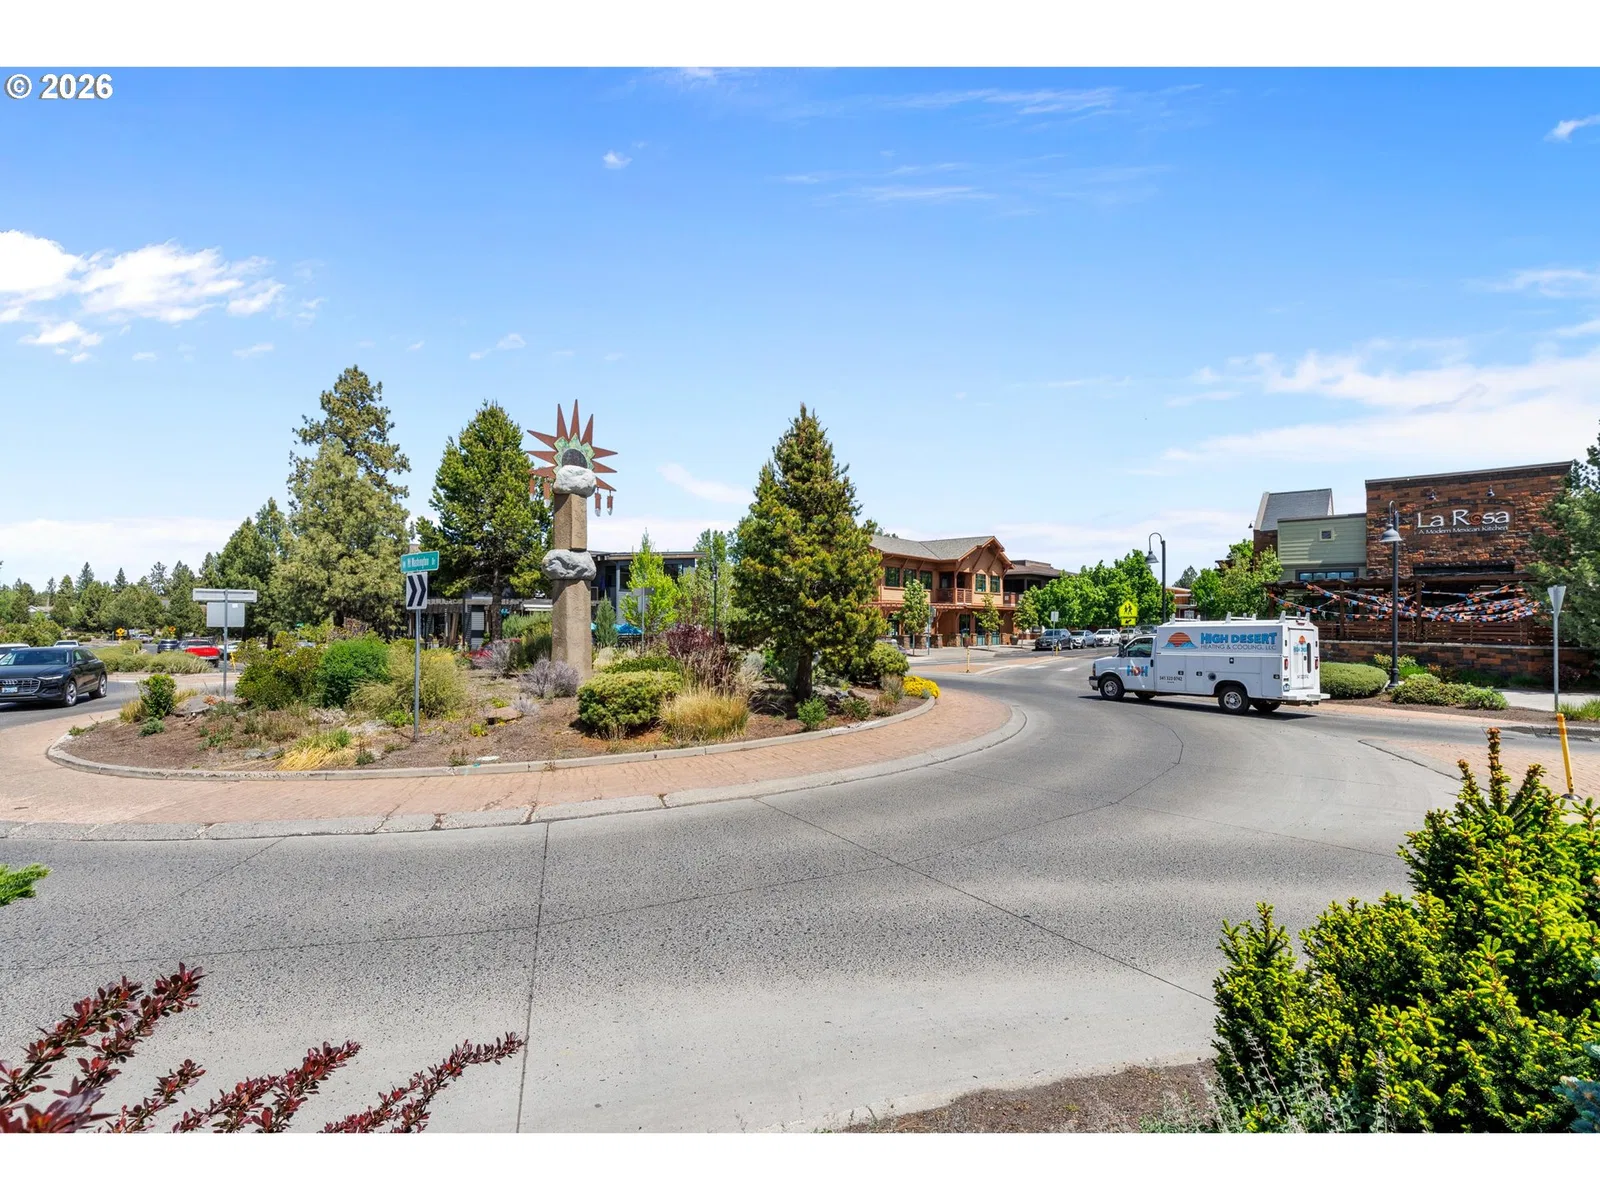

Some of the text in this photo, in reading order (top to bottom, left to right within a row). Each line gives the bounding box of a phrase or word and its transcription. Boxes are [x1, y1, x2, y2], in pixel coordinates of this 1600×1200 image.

[1417, 509, 1510, 528] La Rosa
[1200, 632, 1277, 644] HIGH DESERT
[1126, 665, 1149, 677] HDH
